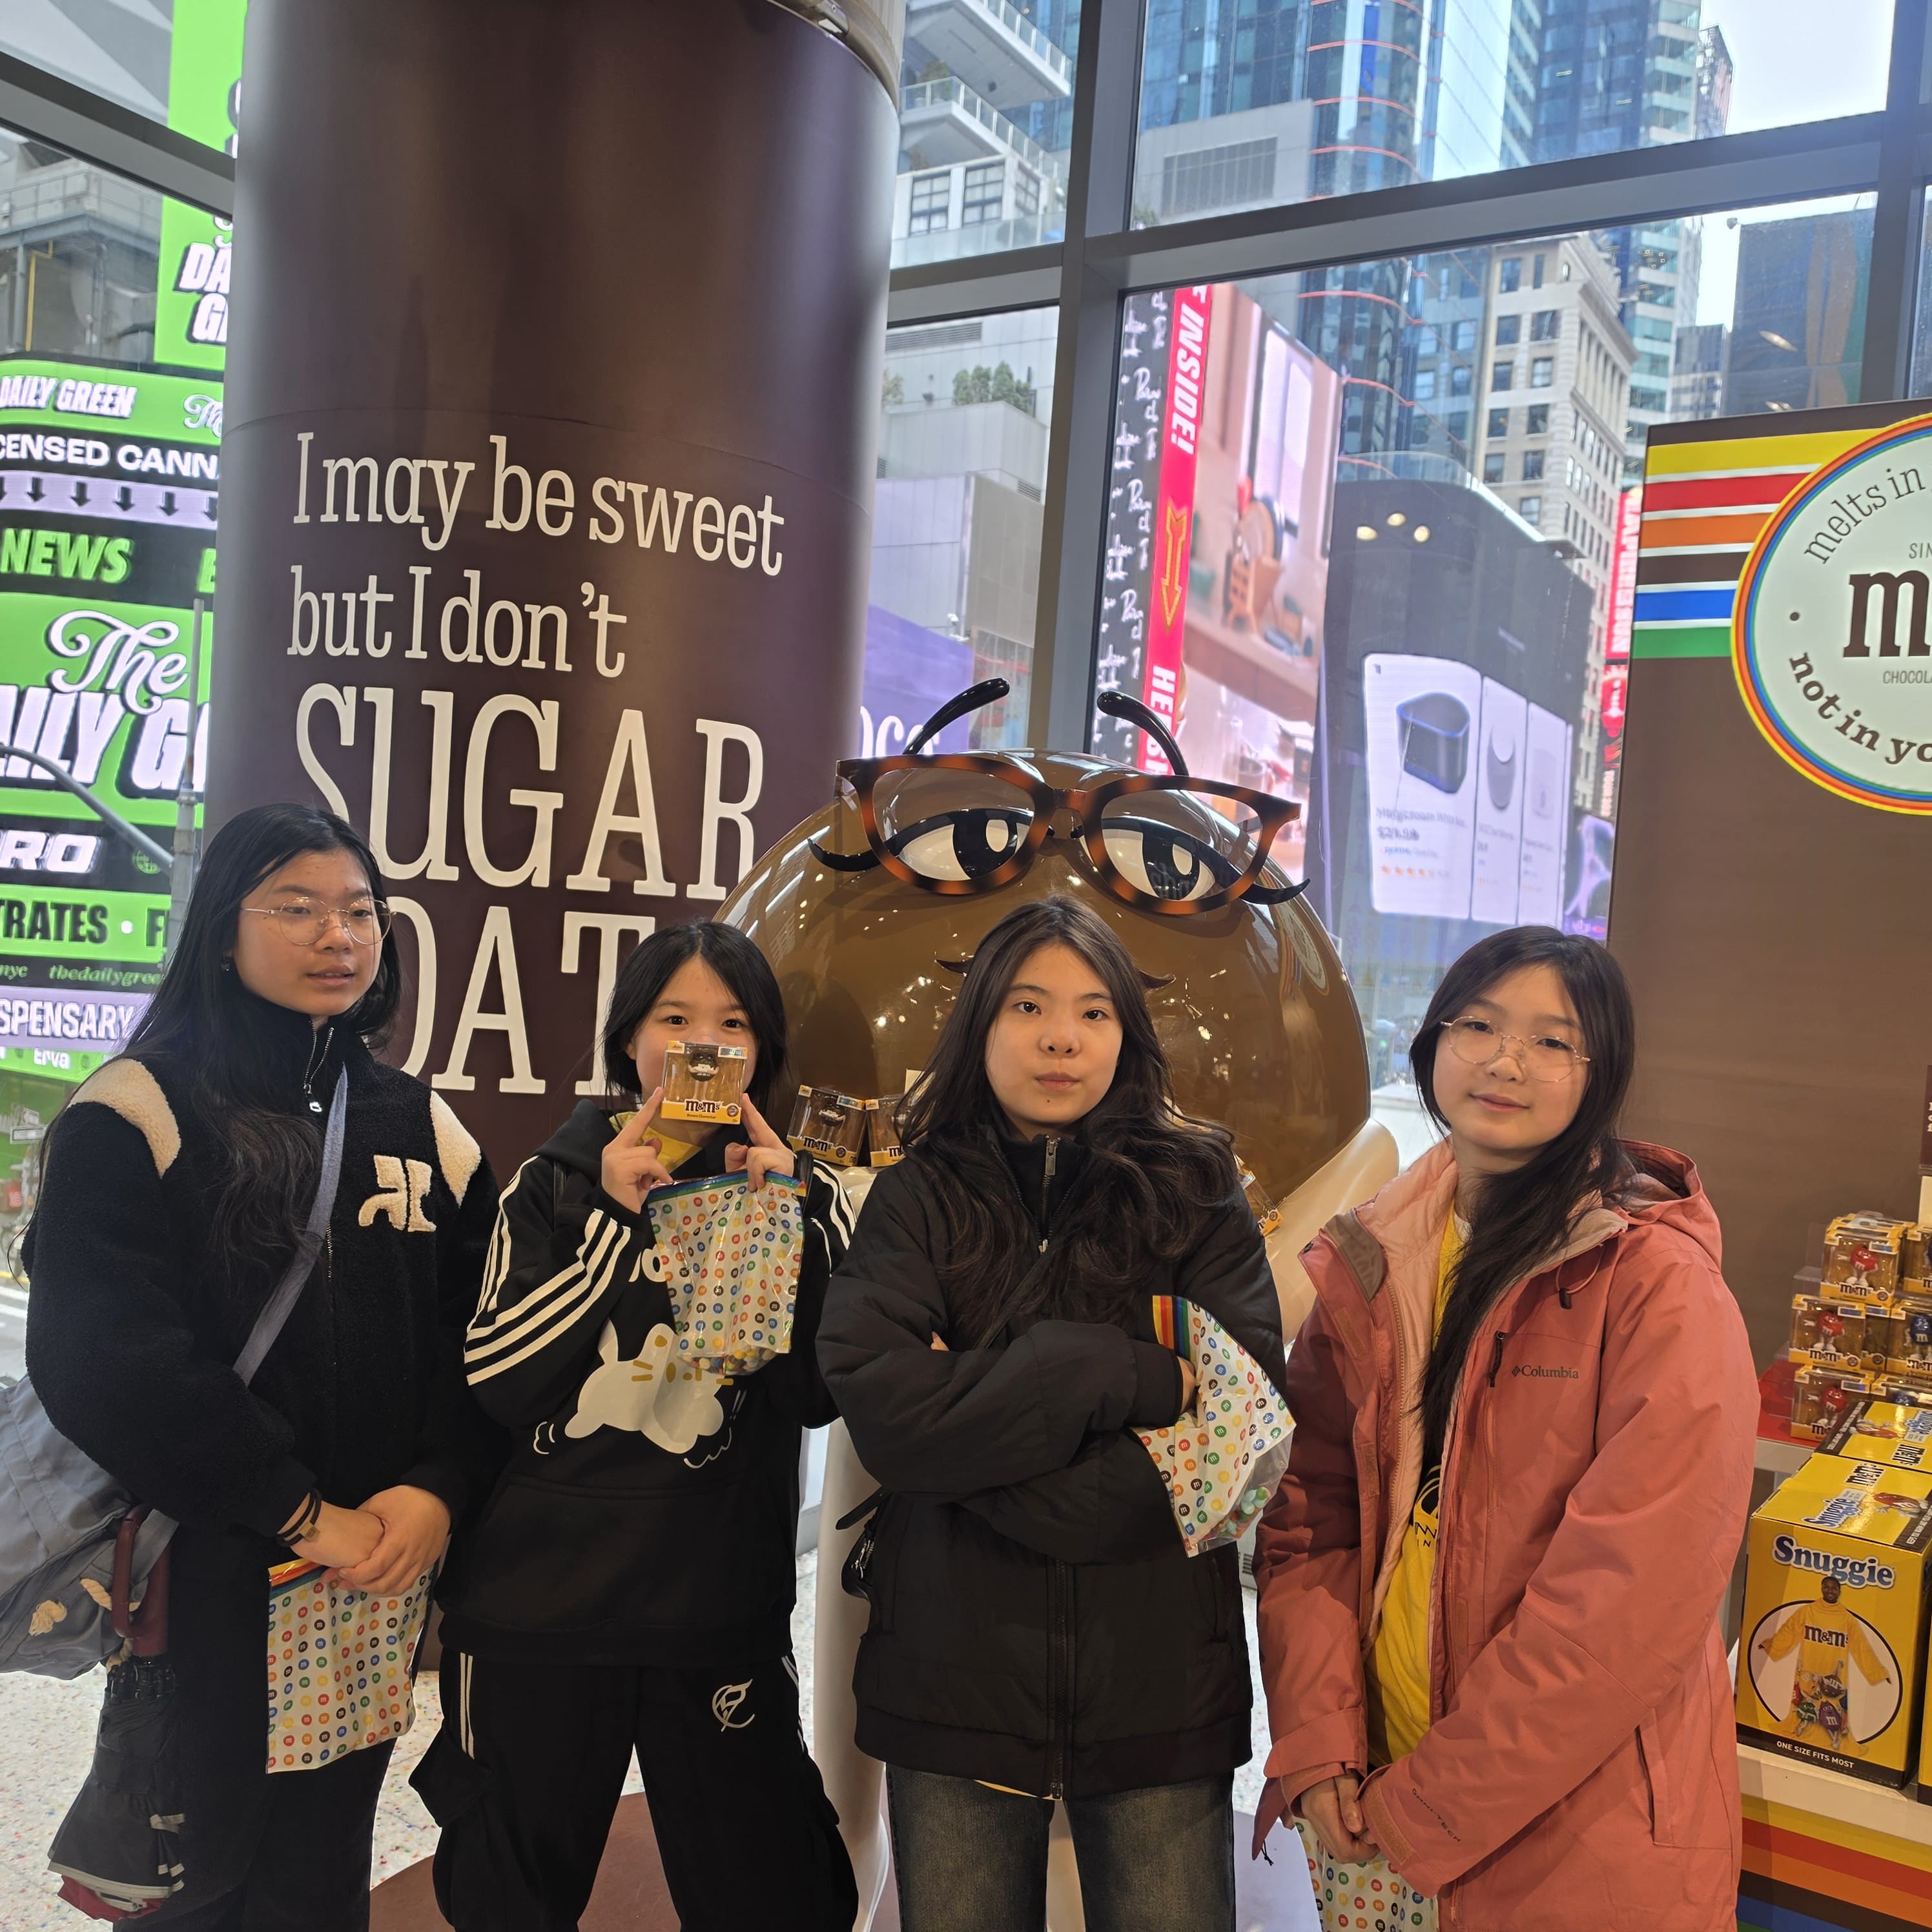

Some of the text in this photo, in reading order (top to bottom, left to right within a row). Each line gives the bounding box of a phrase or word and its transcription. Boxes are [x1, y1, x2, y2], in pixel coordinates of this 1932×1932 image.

[0, 375, 138, 418] DAILY GREEN
[1171, 302, 1204, 455] INSIDE!
[294, 432, 785, 575] I may be sweet
[1804, 468, 1926, 564] melts in
[0, 528, 132, 583] NEWS
[48, 610, 188, 714] The
[287, 564, 627, 677] but I don't
[1789, 652, 1840, 719] not
[1834, 710, 1880, 751] in
[296, 683, 763, 901] SUGAR
[1522, 1364, 1579, 1379] Columbia
[1774, 1536, 1893, 1586] Snuggie
[1776, 1741, 1855, 1768] ONE SIZE FITS MOST
